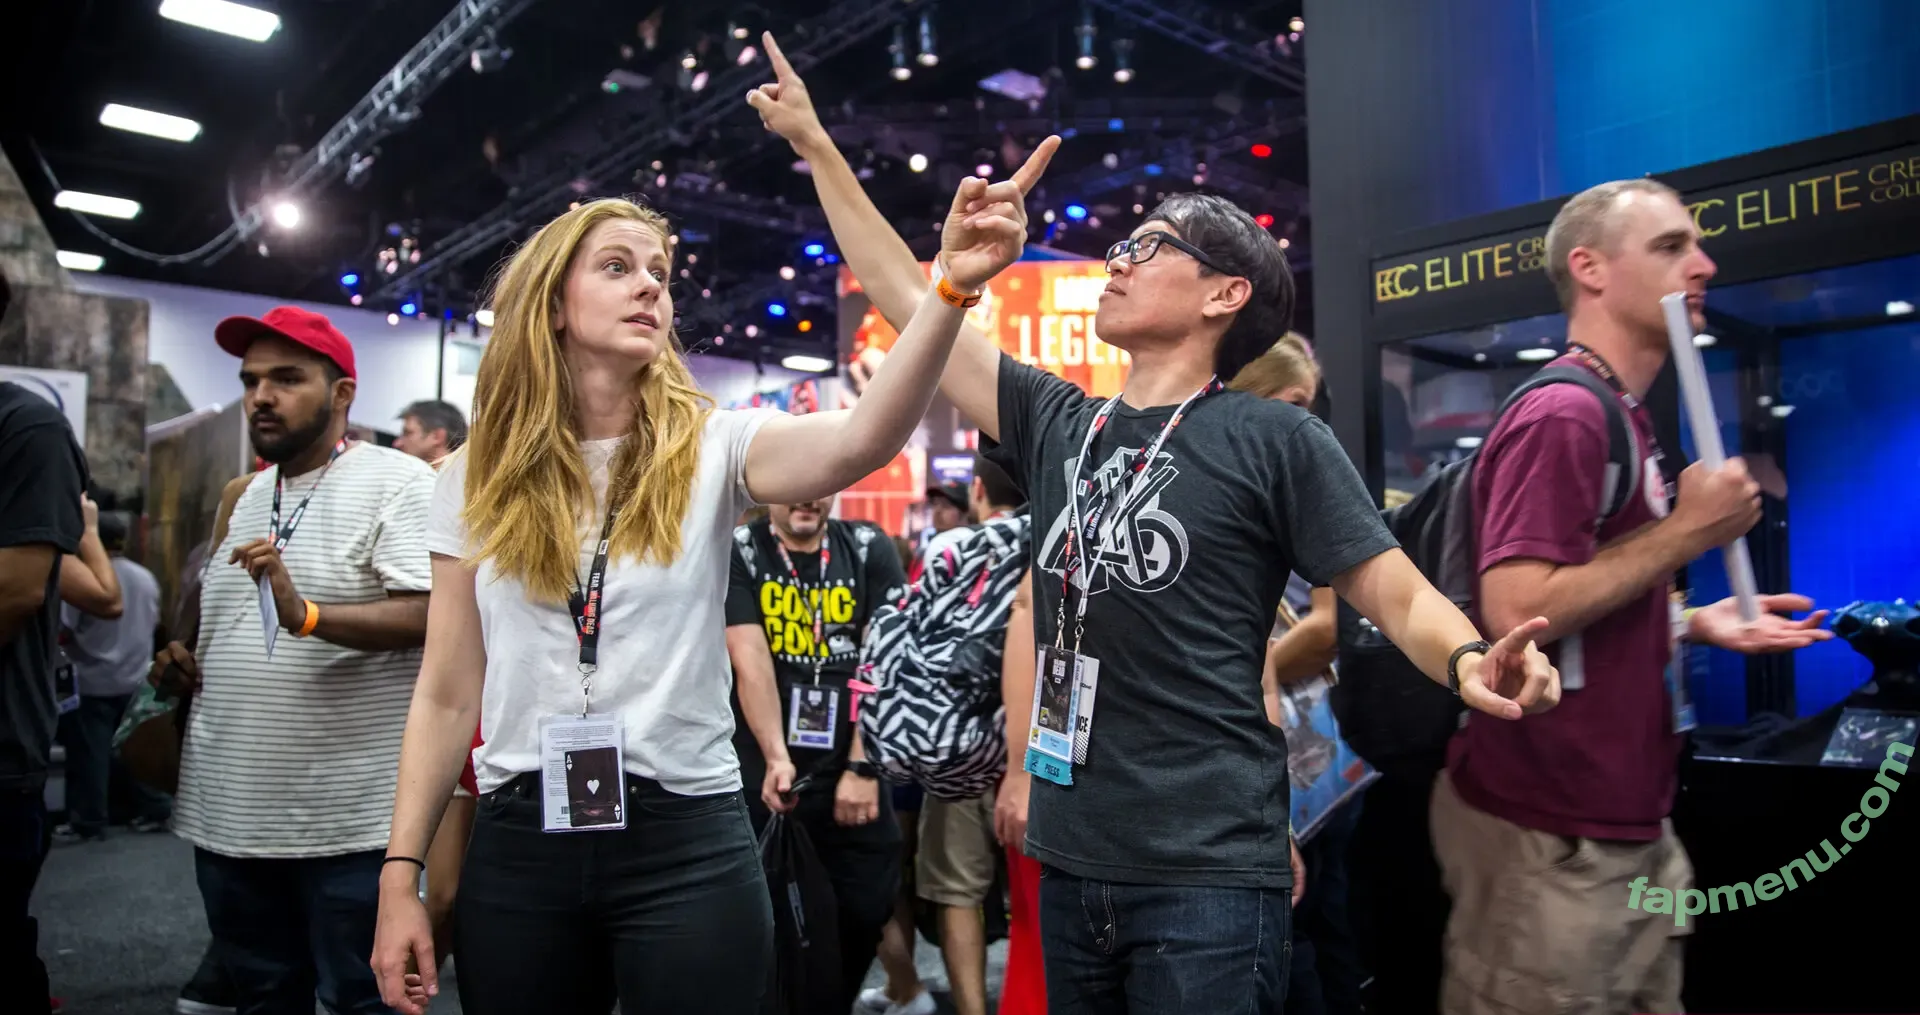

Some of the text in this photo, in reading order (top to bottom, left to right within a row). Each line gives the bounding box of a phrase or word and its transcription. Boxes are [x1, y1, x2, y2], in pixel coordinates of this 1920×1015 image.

[1737, 169, 1861, 230] ELITE
[1517, 237, 1545, 257] CR
[1425, 243, 1513, 291] ELITE
[566, 754, 572, 763] A
[1045, 763, 1060, 777] PRESS
